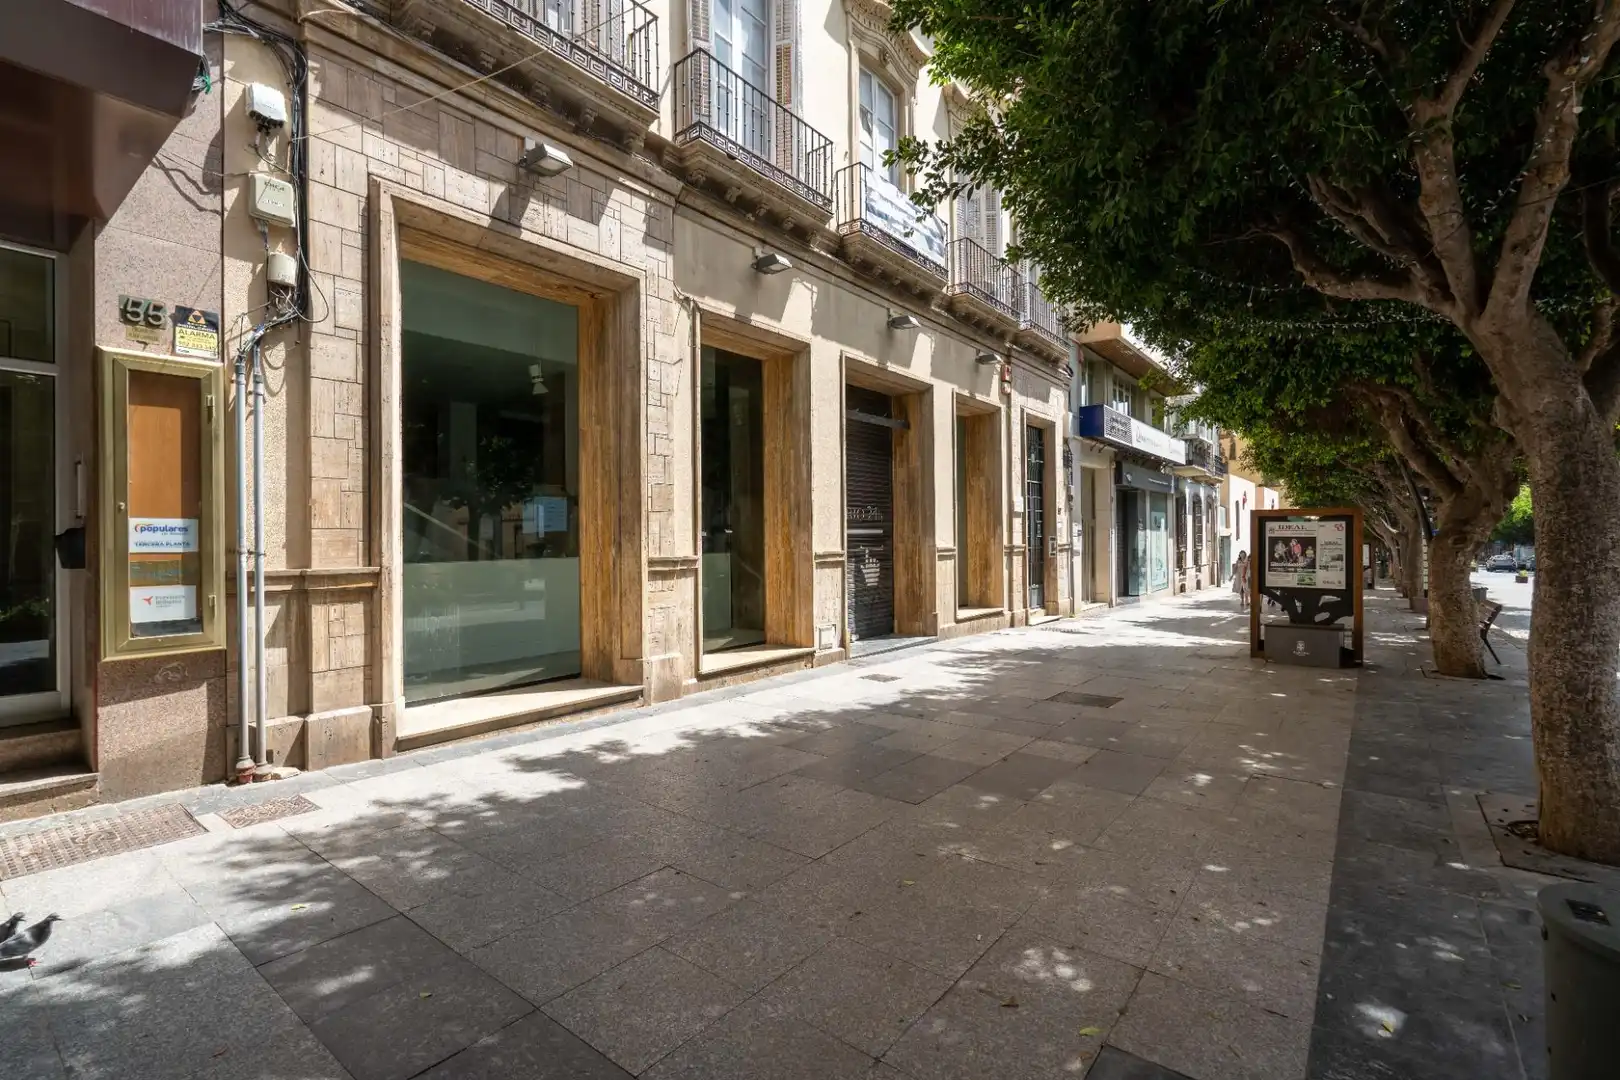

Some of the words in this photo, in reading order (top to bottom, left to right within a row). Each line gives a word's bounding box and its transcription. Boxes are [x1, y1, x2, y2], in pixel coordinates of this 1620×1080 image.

[126, 298, 164, 325] 55
[178, 329, 216, 340] ALARMA
[140, 524, 189, 534] populares
